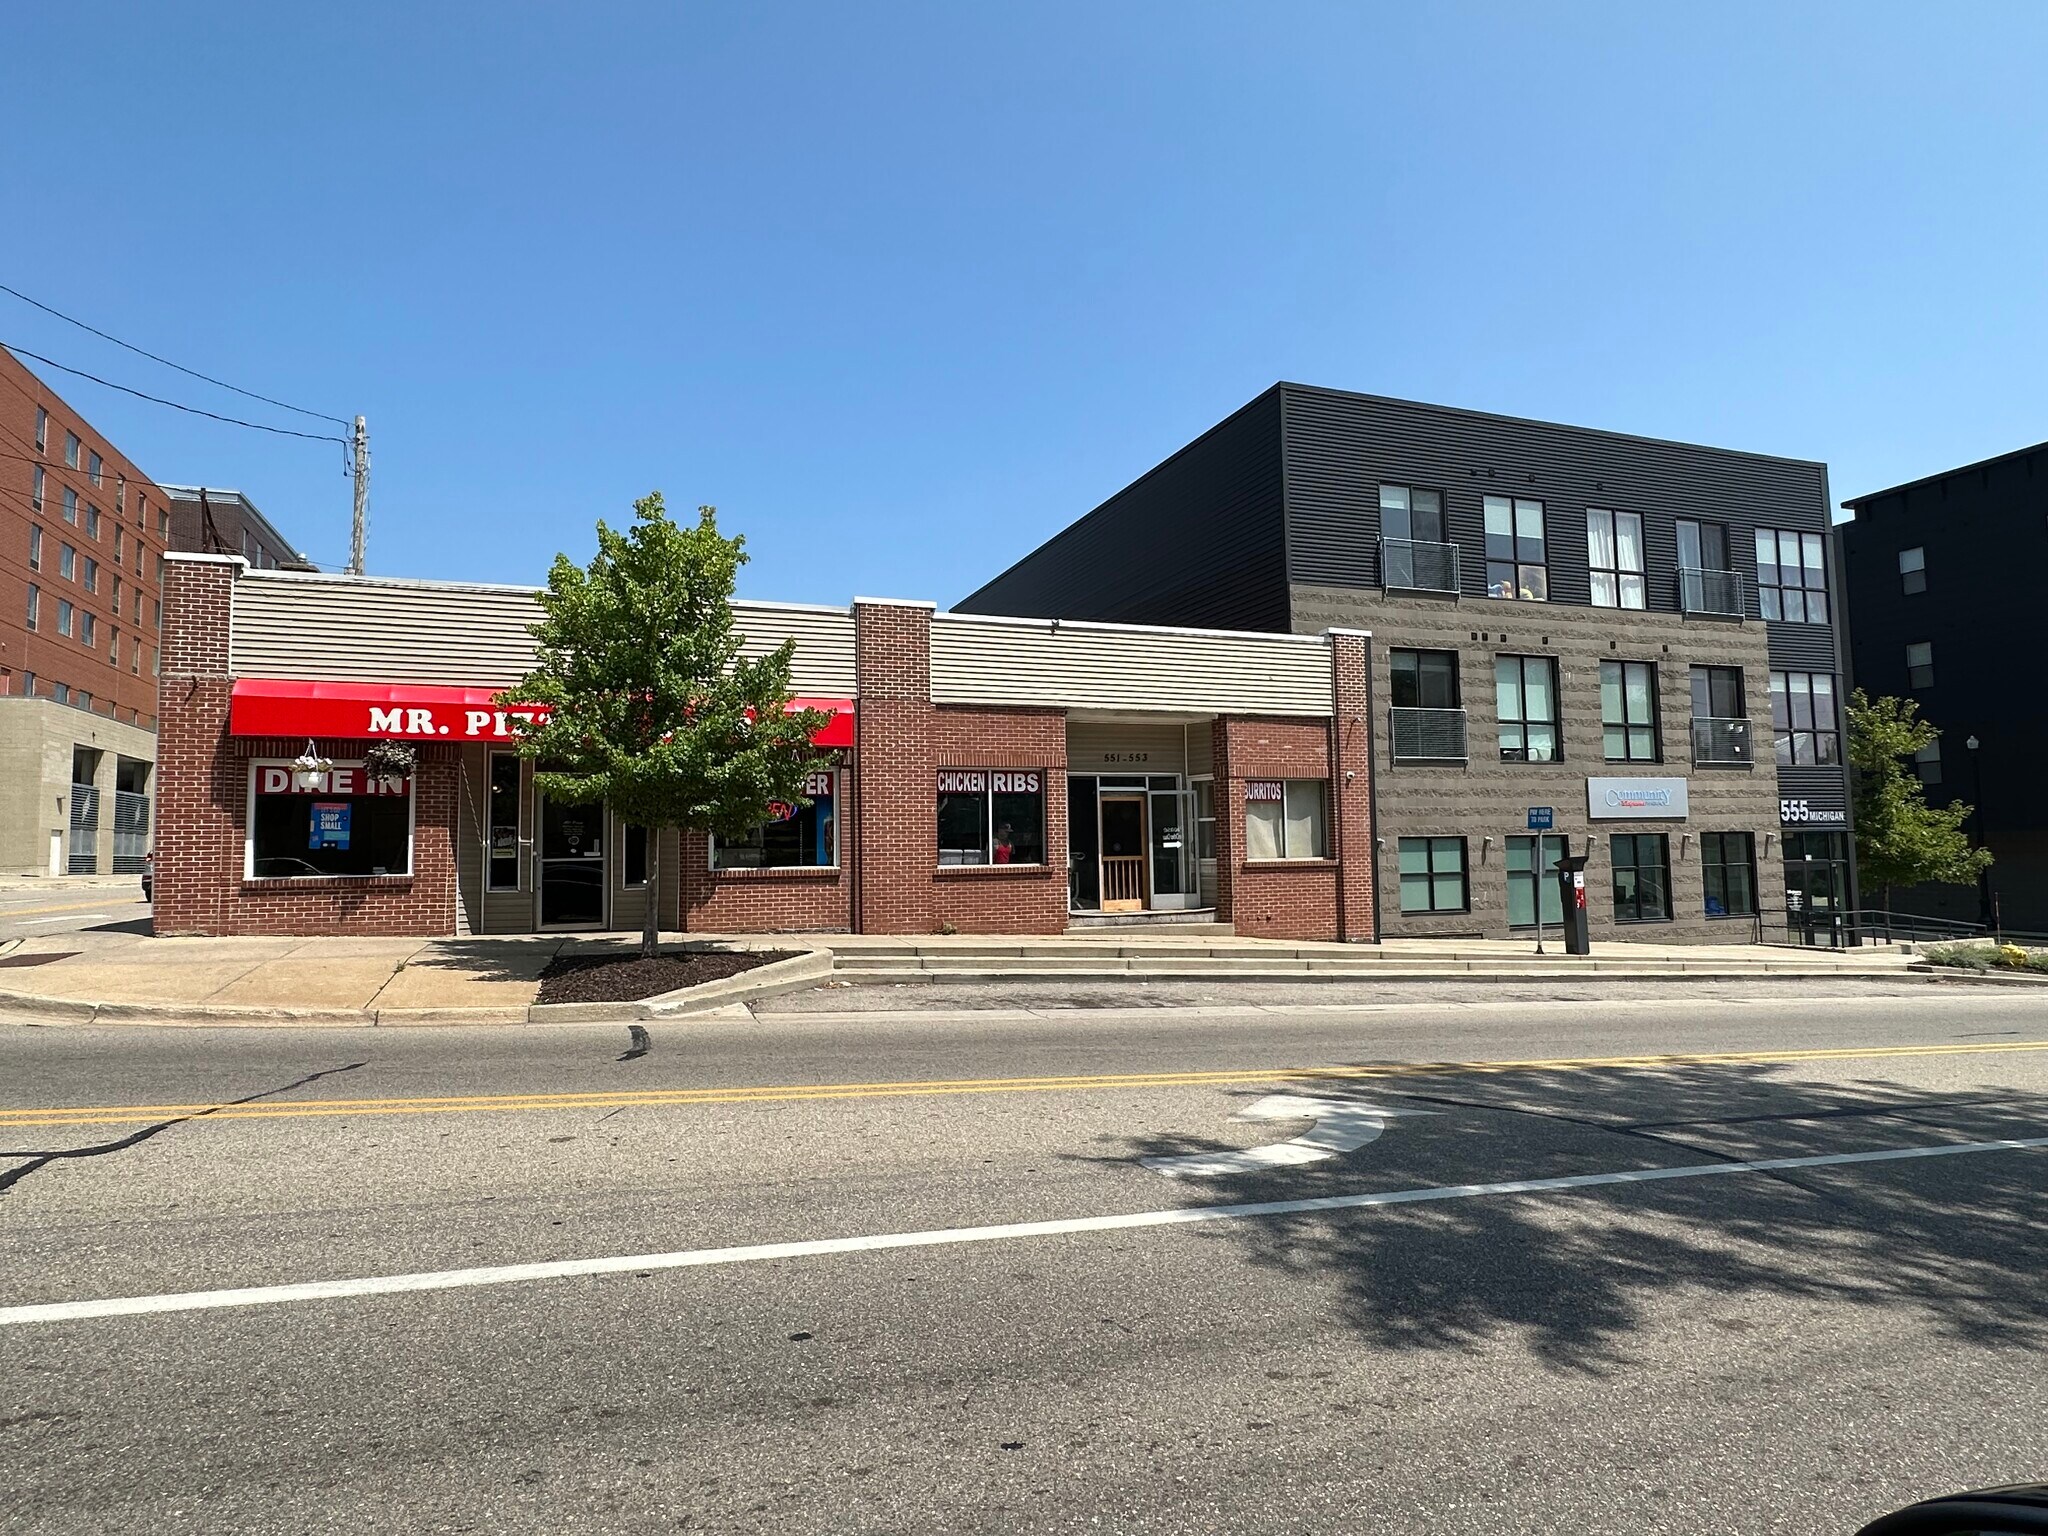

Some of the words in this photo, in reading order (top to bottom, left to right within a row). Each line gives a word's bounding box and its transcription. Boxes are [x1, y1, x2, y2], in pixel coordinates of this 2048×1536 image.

[367, 707, 449, 734] MR.
[937, 772, 985, 791] CHICKEN
[993, 773, 1039, 792] RIBS
[320, 813, 340, 822] SHOP
[1780, 800, 1809, 821] 555
[1809, 811, 1845, 821] MICHIGAN
[320, 822, 342, 830] SMALL
